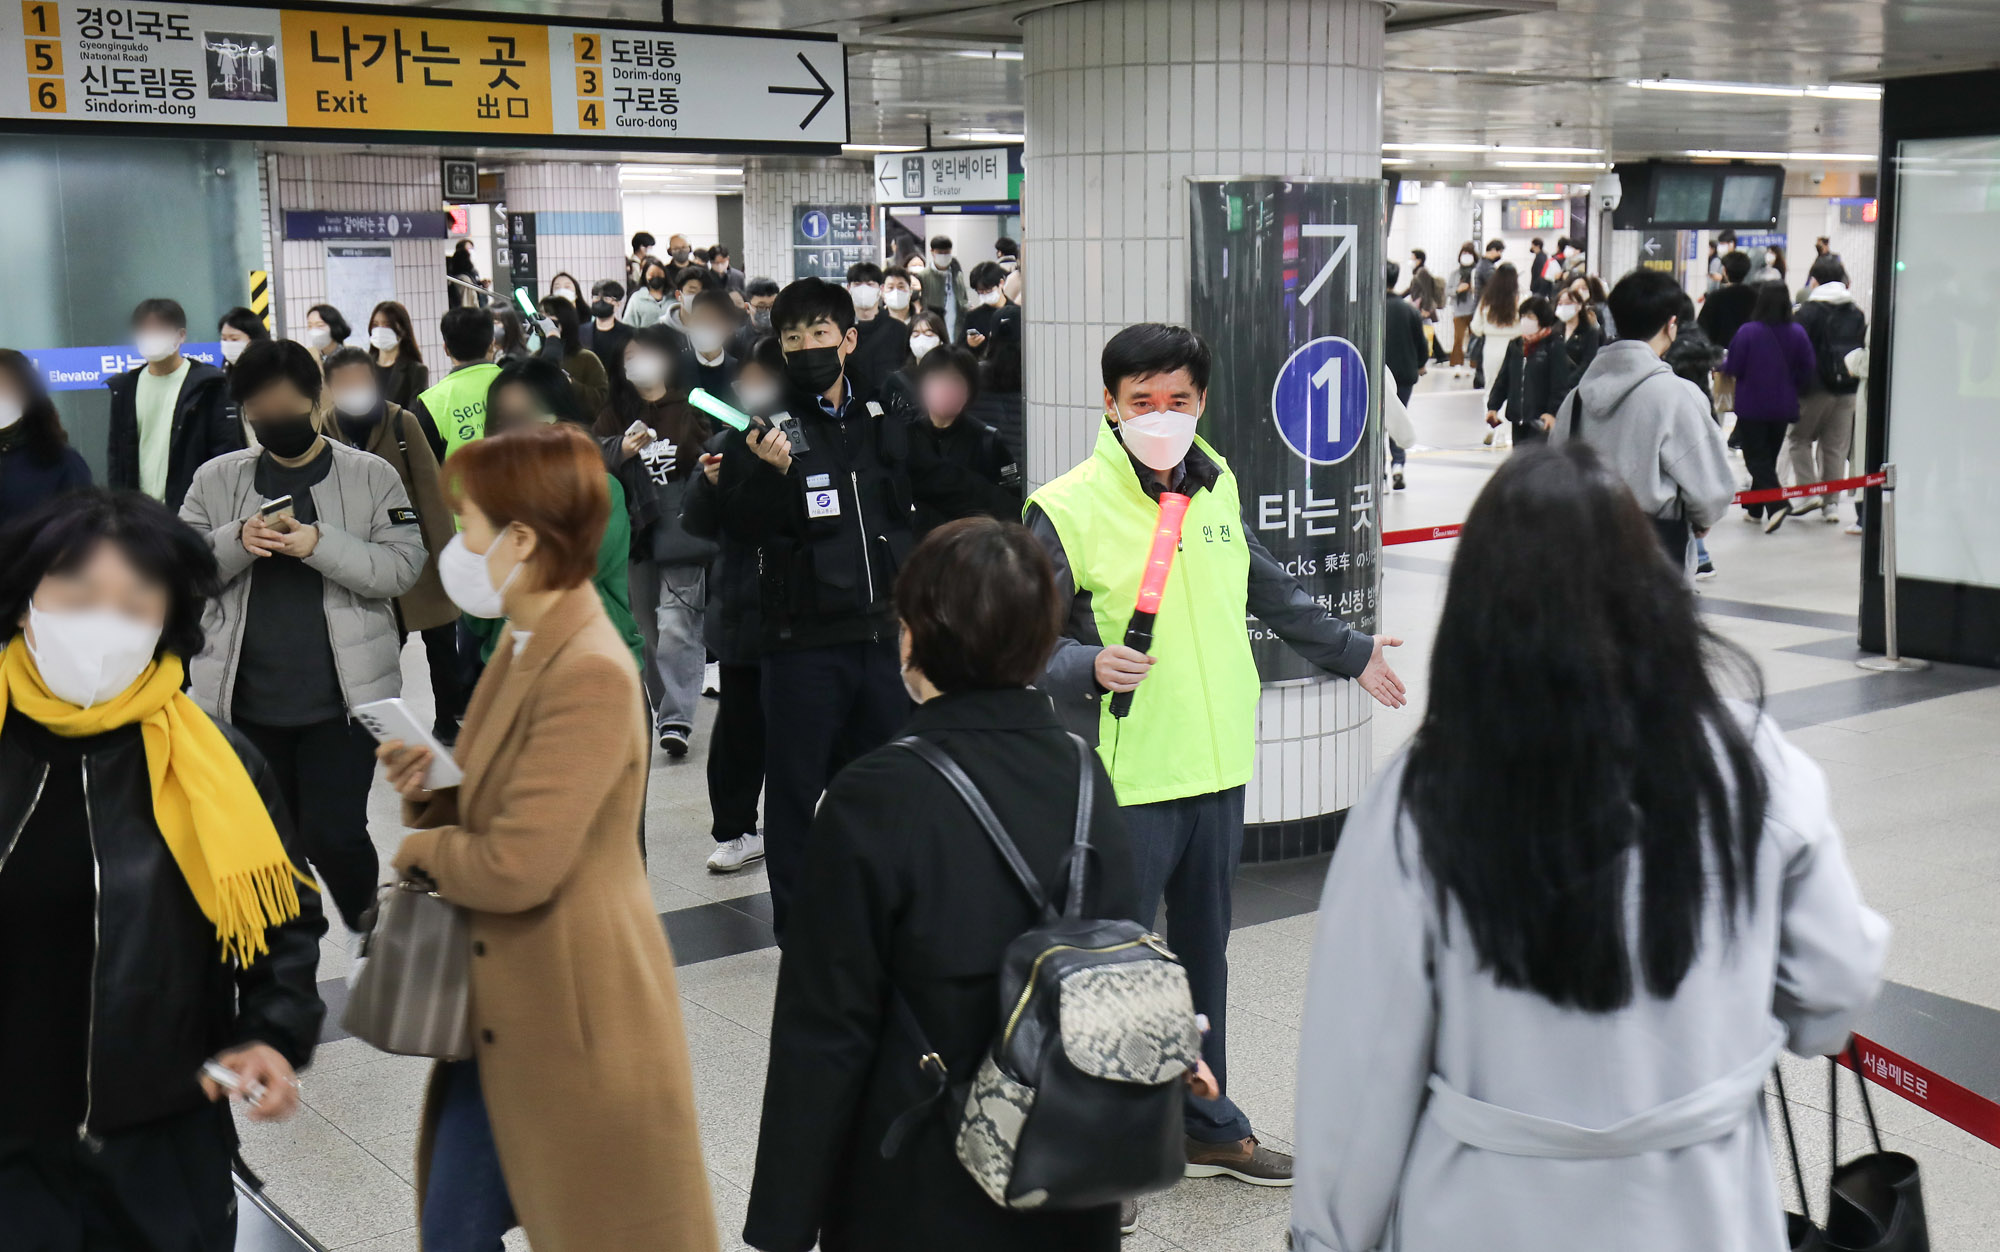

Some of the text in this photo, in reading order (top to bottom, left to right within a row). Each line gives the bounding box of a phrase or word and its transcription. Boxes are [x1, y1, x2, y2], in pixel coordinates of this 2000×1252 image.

[31, 5, 46, 32] 1
[77, 7, 194, 42] 경인국도
[35, 44, 54, 71] 5
[80, 40, 149, 52] Gyeongingukdo
[80, 51, 148, 63] (National Road)
[310, 26, 527, 90] 나가는 곳
[580, 38, 596, 60] 2
[610, 39, 677, 68] 도림동
[80, 65, 197, 100] 신도림동
[582, 70, 597, 93] 3
[613, 67, 681, 84] Dorim-dong
[37, 82, 57, 108] 6
[316, 90, 368, 114] Exit
[477, 93, 529, 119] 出口
[613, 87, 679, 114] 구로동
[85, 98, 196, 118] Sindorim-dong
[582, 103, 599, 126] 4
[616, 115, 677, 131] Guro-dong
[932, 155, 997, 182] 엘리베이터
[933, 186, 961, 195] Elevator
[808, 214, 819, 236] 1
[832, 212, 857, 229] 타는
[50, 370, 99, 382] Elevator
[1311, 356, 1341, 443] 1
[1259, 484, 1373, 538] 타는 곳
[1248, 629, 1263, 640] To
[1863, 1051, 1929, 1100] 서울메트로
